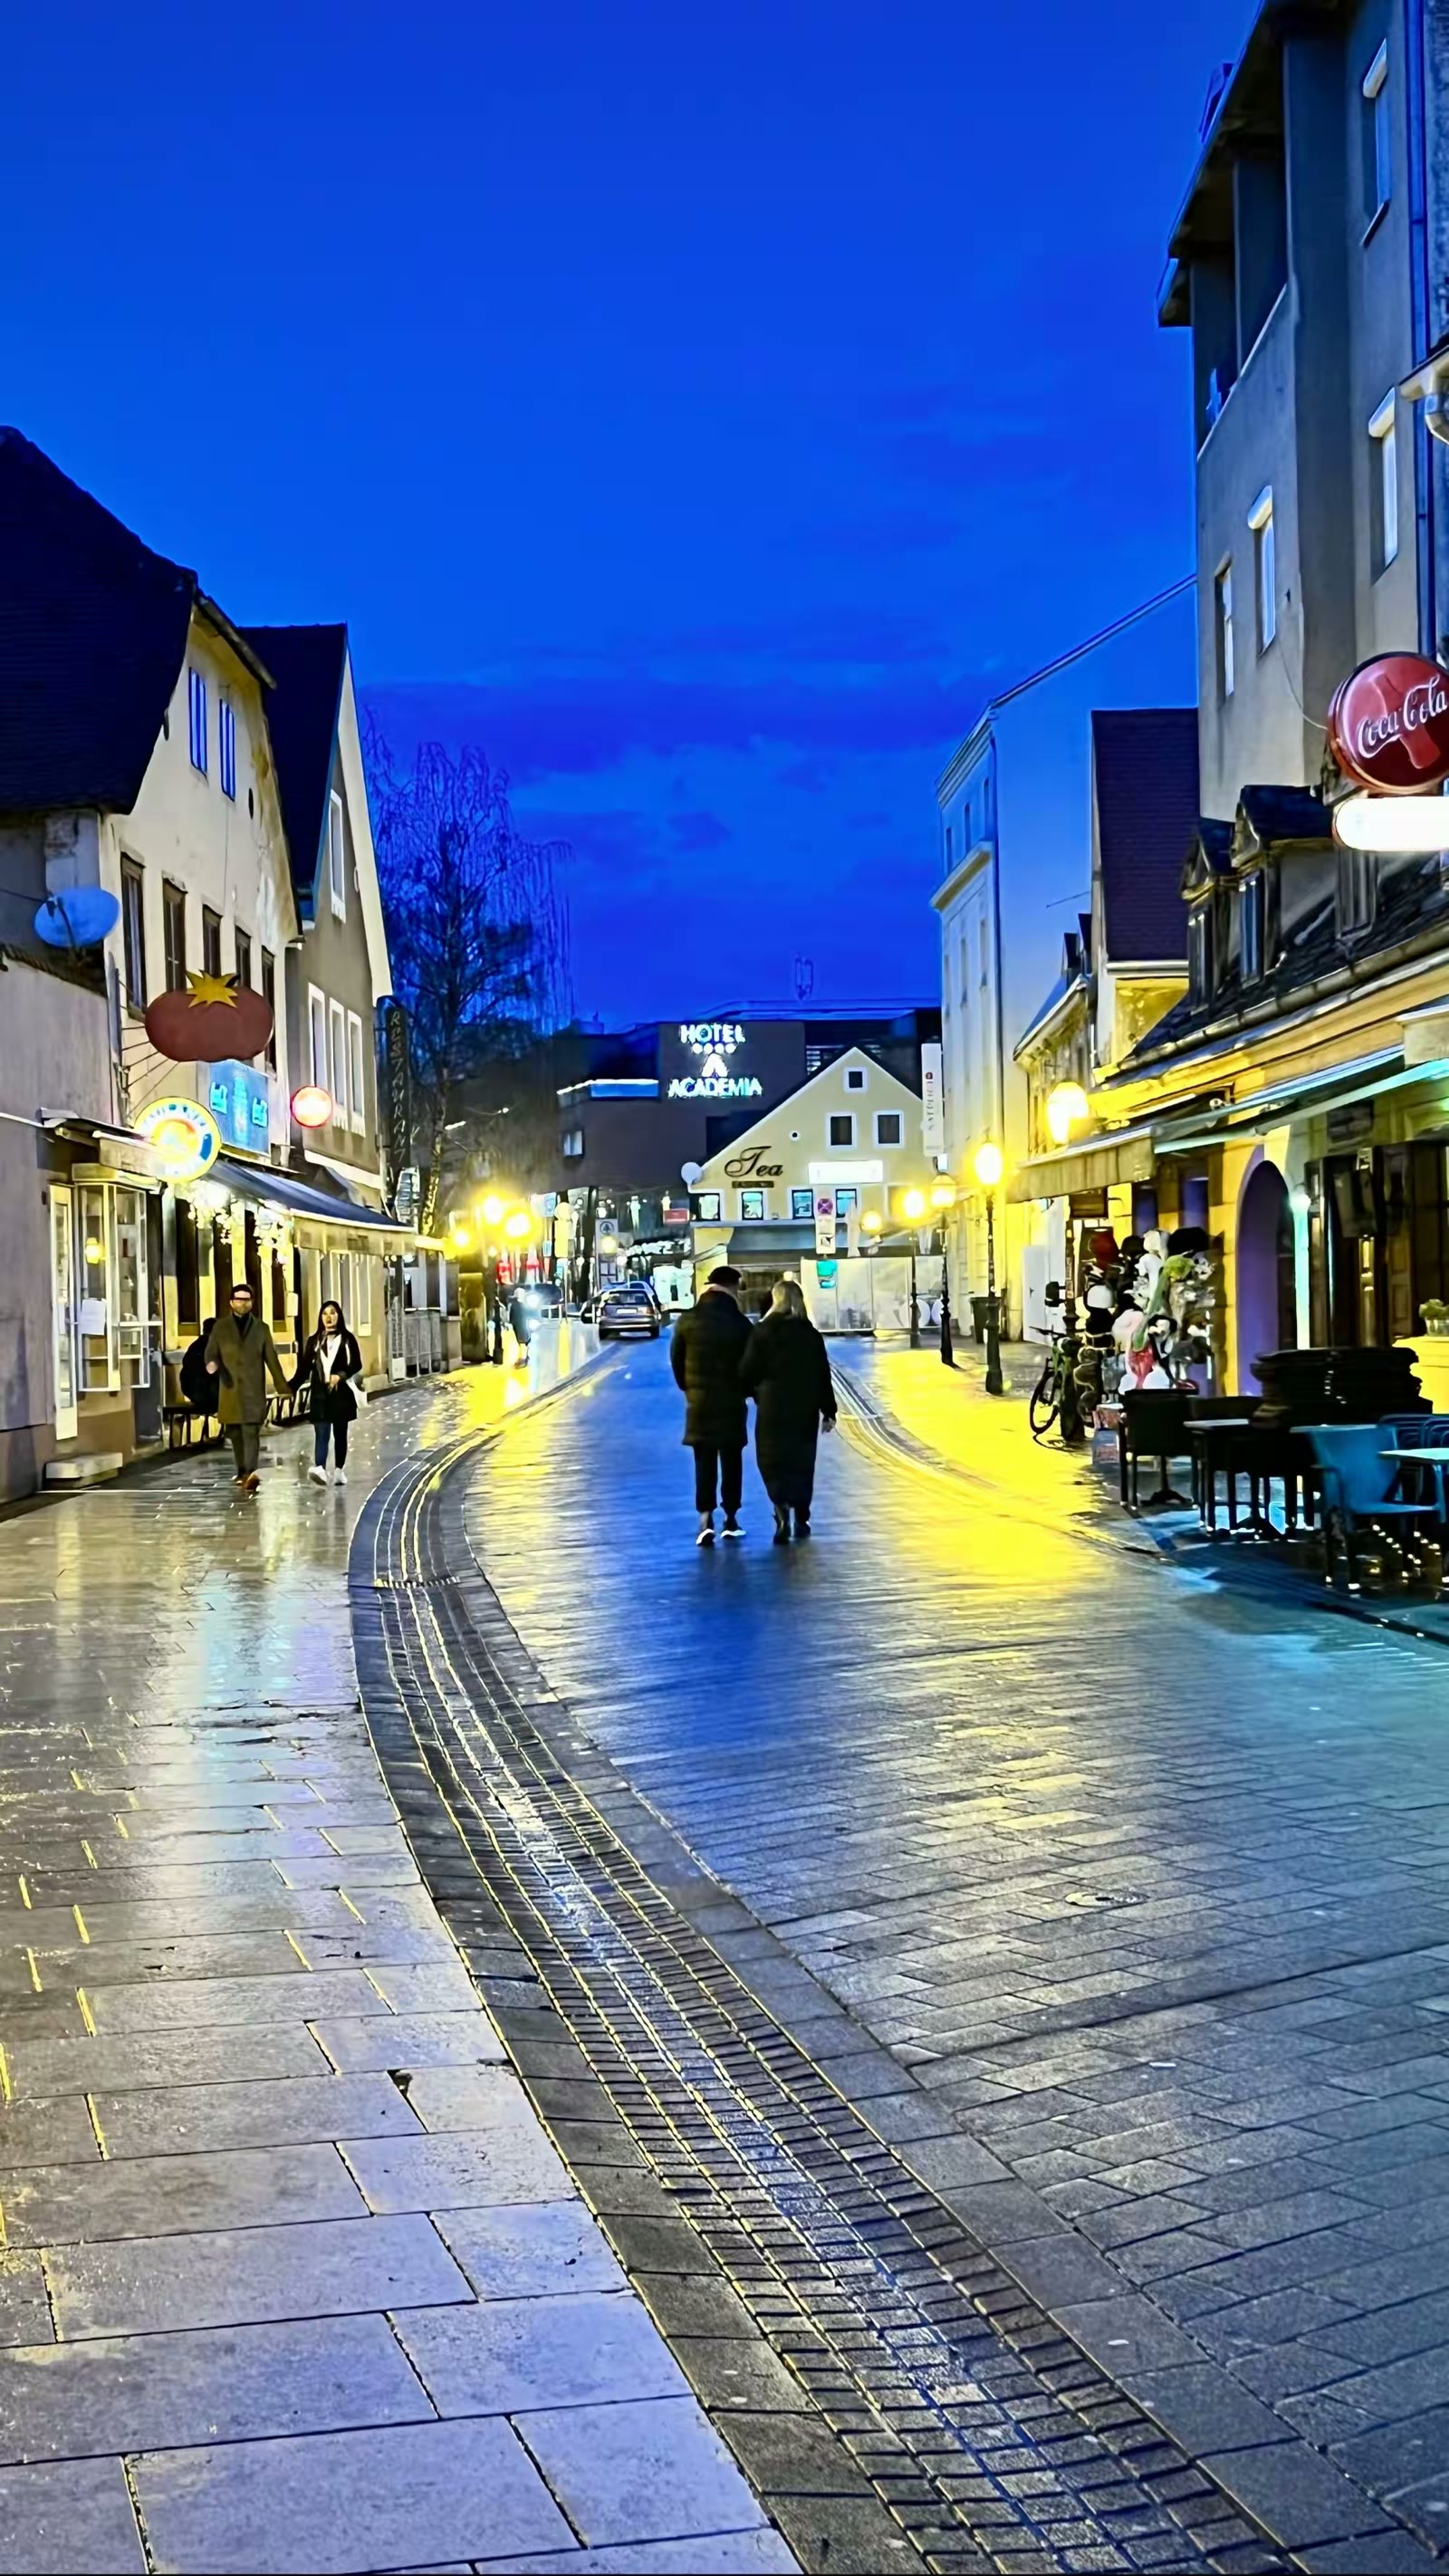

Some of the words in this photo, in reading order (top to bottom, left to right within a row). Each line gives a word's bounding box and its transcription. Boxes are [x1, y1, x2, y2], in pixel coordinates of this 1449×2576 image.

[680, 1024, 746, 1043] HOTEL
[390, 1011, 406, 1163] RESTAURANT
[667, 1077, 763, 1098] ACADEMIA
[724, 1145, 783, 1177] Tea
